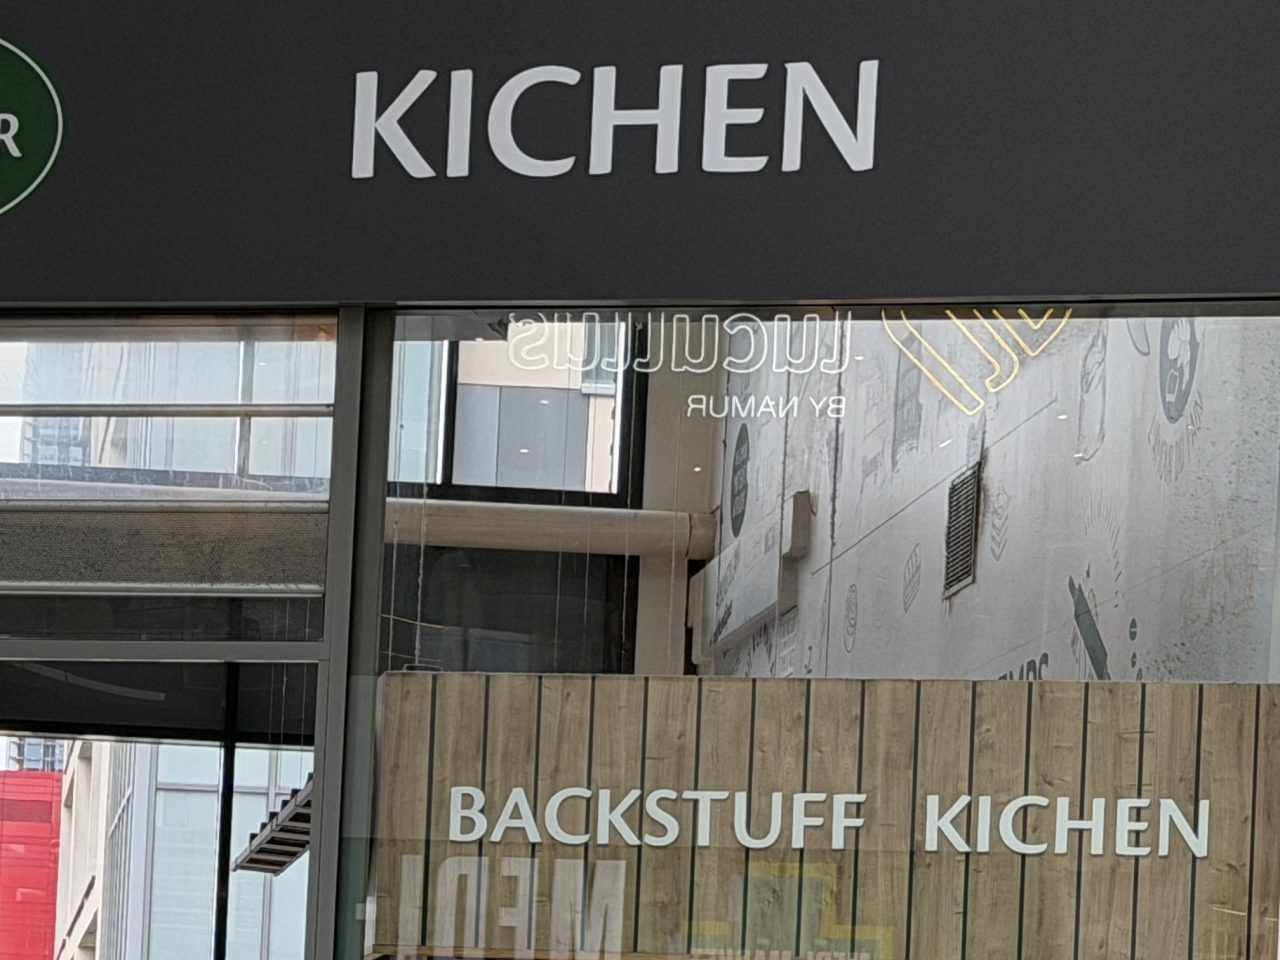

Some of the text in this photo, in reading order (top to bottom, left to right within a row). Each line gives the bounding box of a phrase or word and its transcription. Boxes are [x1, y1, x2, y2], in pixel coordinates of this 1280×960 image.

[351, 59, 880, 179] KICHEN
[448, 785, 1211, 858] BACKSTUFF KICHEN
